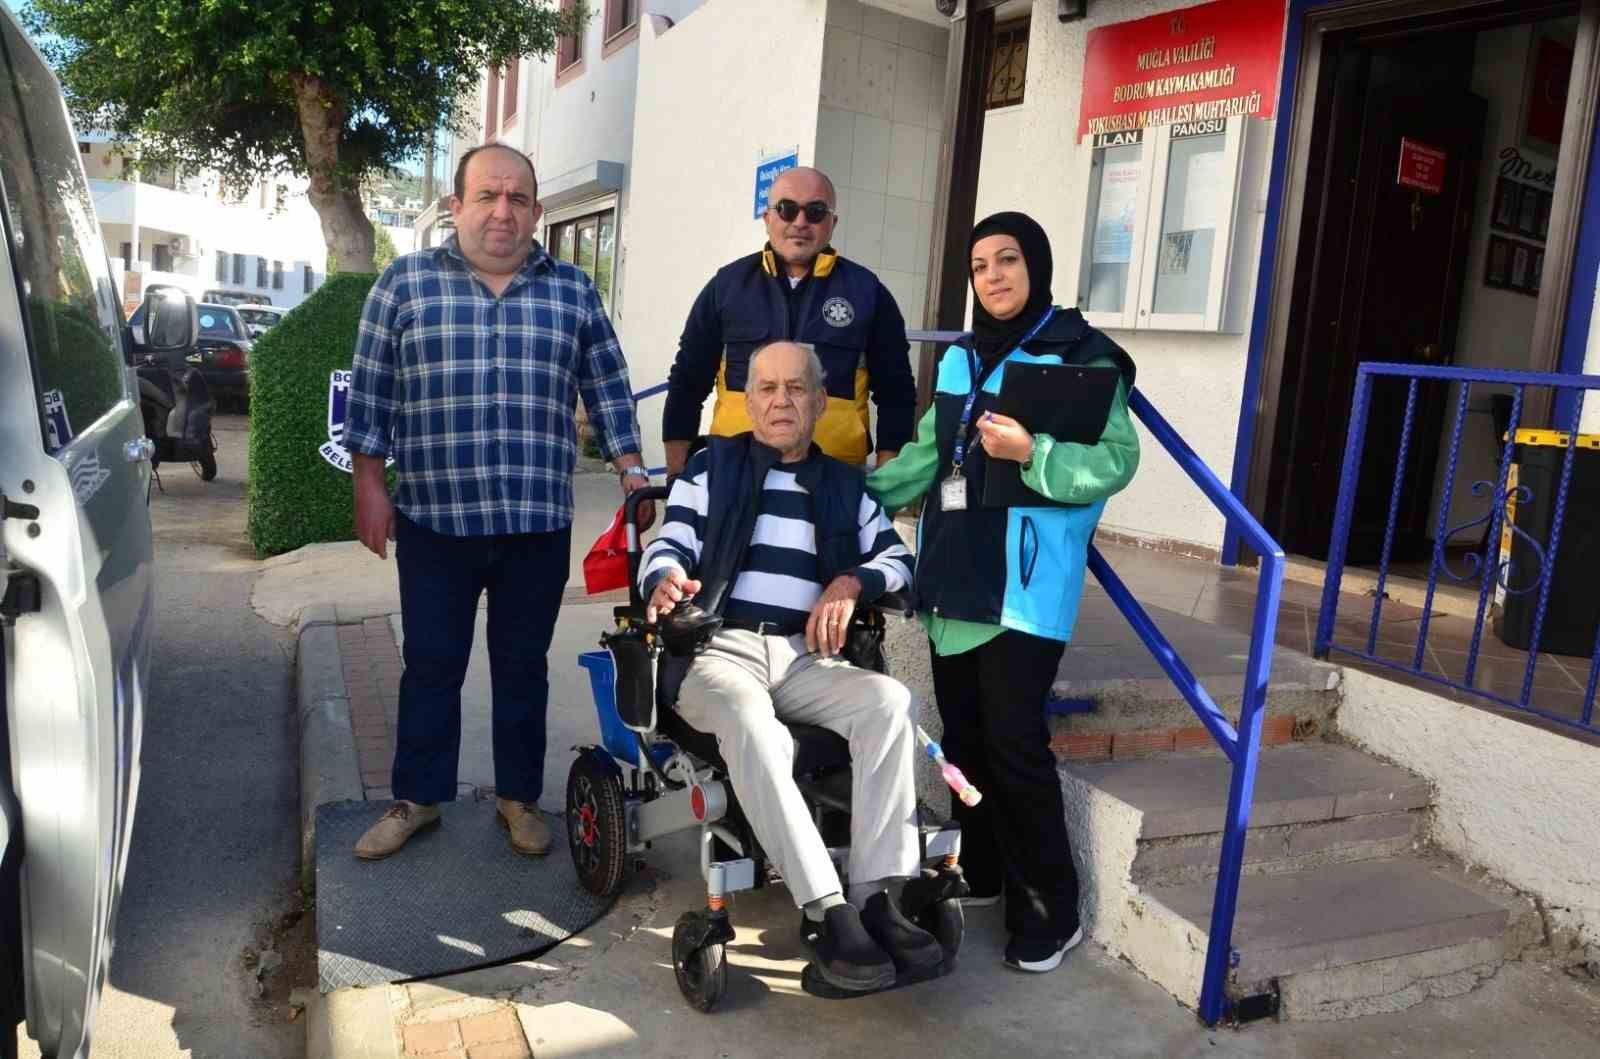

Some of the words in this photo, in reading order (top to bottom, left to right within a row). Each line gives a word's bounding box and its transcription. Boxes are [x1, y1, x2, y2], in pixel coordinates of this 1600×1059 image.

[1113, 80, 1155, 103] BODRUM
[1156, 64, 1235, 97] KAYMAKAMLIĞI
[1194, 90, 1261, 121] MUHTARLIĞI
[1172, 120, 1224, 137] PANOSU
[322, 446, 353, 470] BELE
